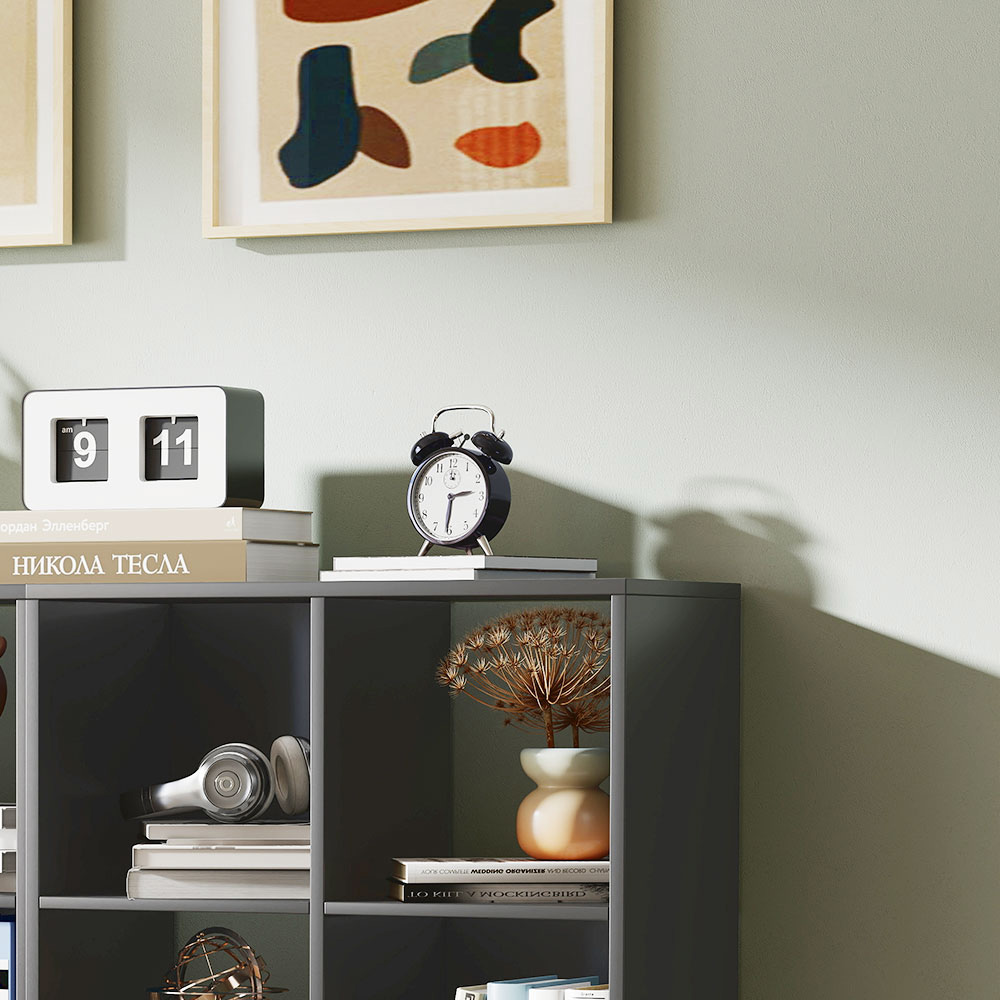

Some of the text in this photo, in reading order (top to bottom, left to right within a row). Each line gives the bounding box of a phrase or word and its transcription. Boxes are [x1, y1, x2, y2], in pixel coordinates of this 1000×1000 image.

[73, 431, 97, 468] 9
[152, 428, 192, 466] 11
[436, 463, 443, 473] 11
[449, 458, 458, 468] 12
[424, 476, 433, 486] 10
[475, 474, 480, 484] 2
[418, 494, 424, 503] 9
[479, 491, 484, 501] 3
[42, 518, 110, 534] Элленберг
[433, 521, 438, 531] 7
[464, 521, 469, 530] 5
[12, 553, 190, 576] НИКОЛА ТЕСЛА
